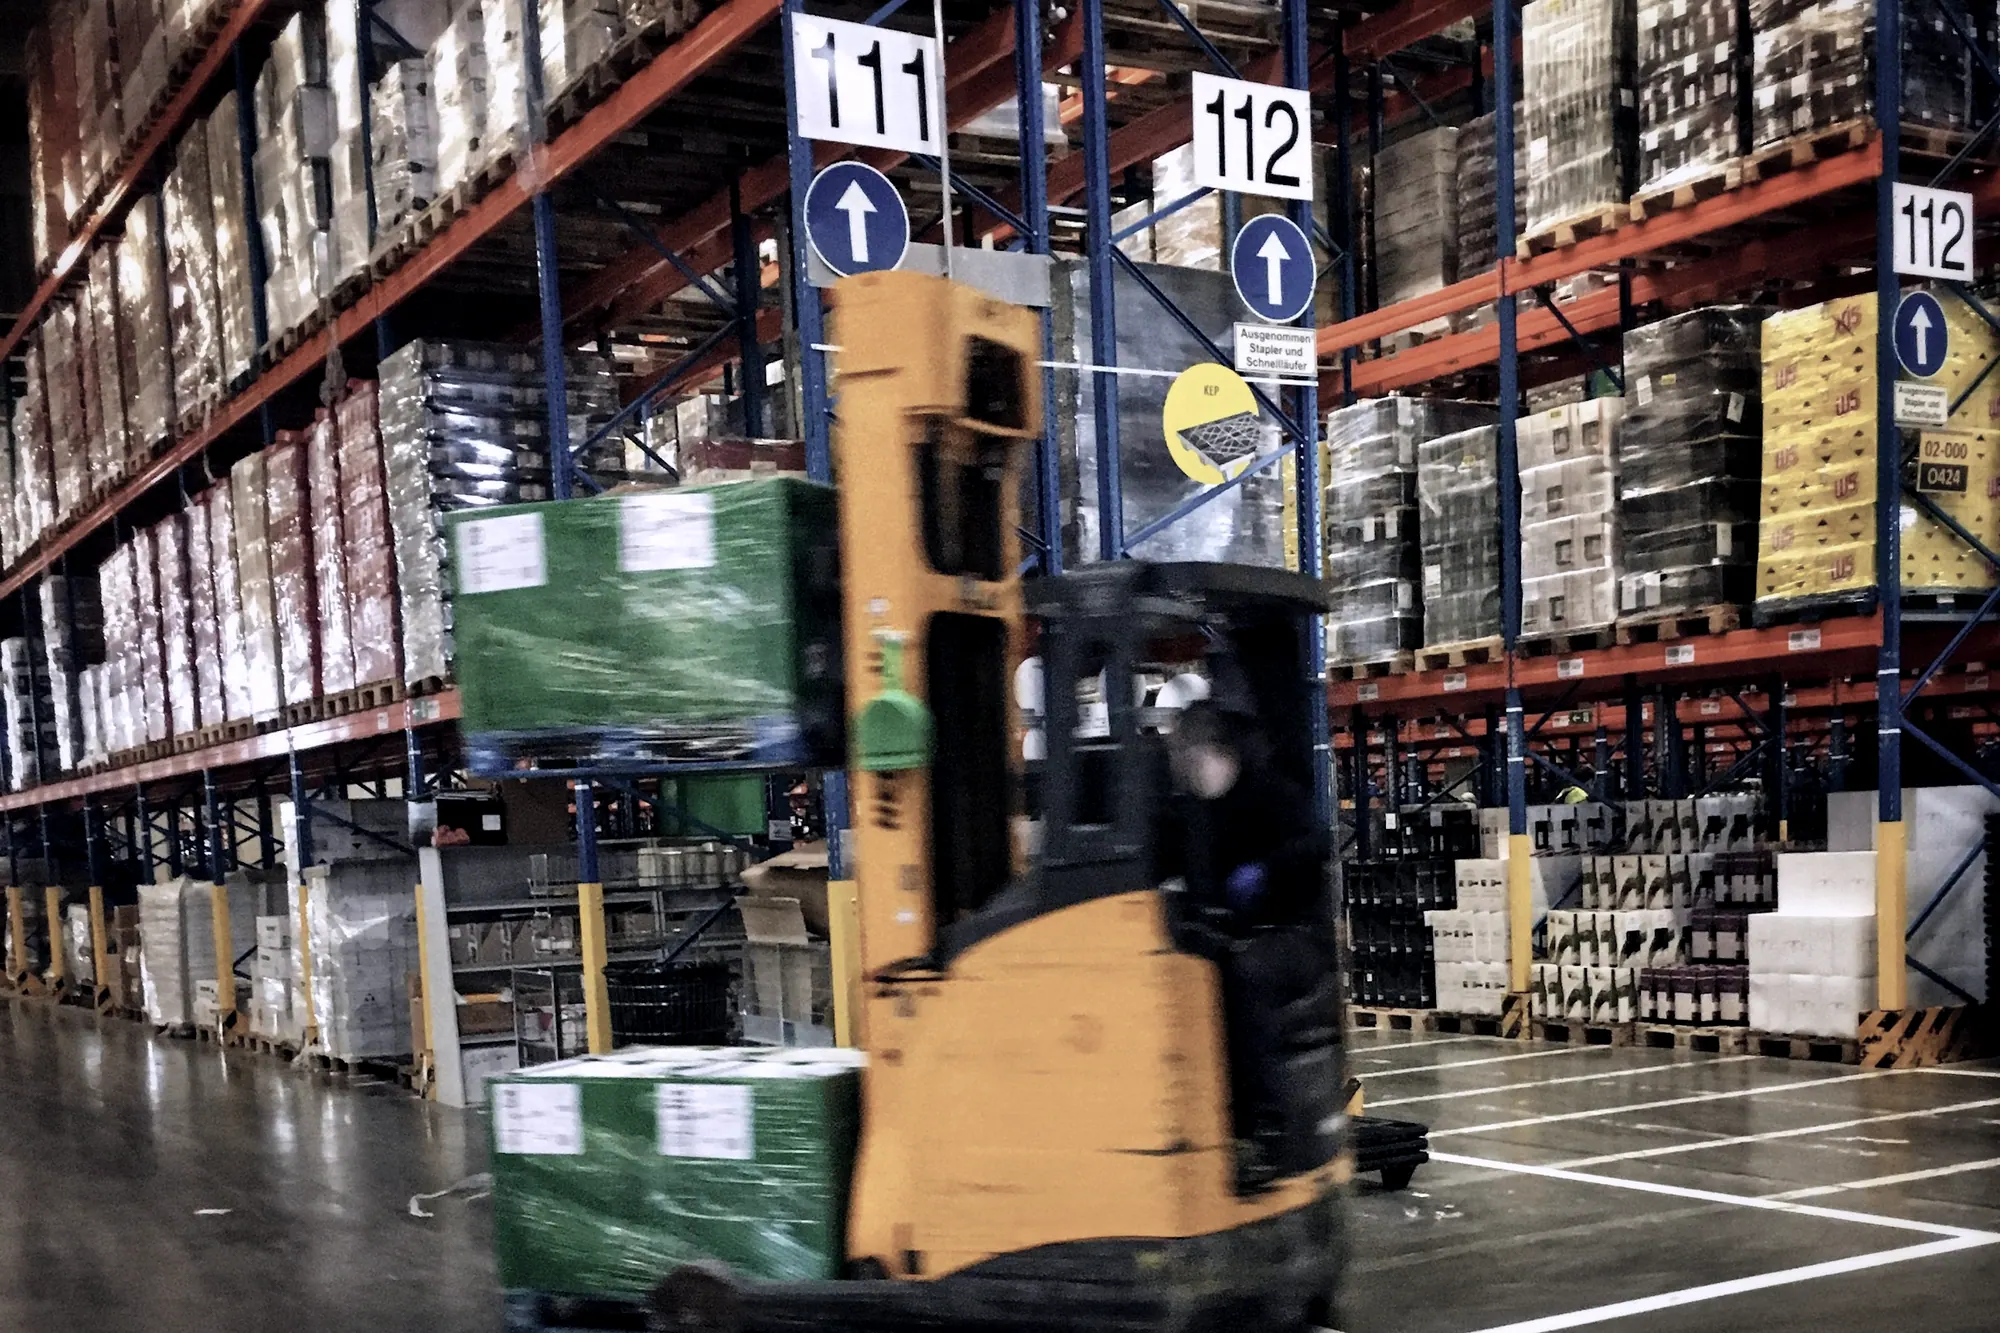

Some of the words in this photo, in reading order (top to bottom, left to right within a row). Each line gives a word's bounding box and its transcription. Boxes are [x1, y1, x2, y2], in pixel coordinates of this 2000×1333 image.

[811, 32, 929, 141] 111
[1206, 89, 1300, 187] 112
[1902, 194, 1965, 271] 112
[1240, 328, 1311, 343] Ausgenommen
[1249, 343, 1283, 356] Stapler
[1285, 347, 1303, 357] und
[1203, 384, 1220, 397] KEP
[1924, 440, 1968, 460] 02-000
